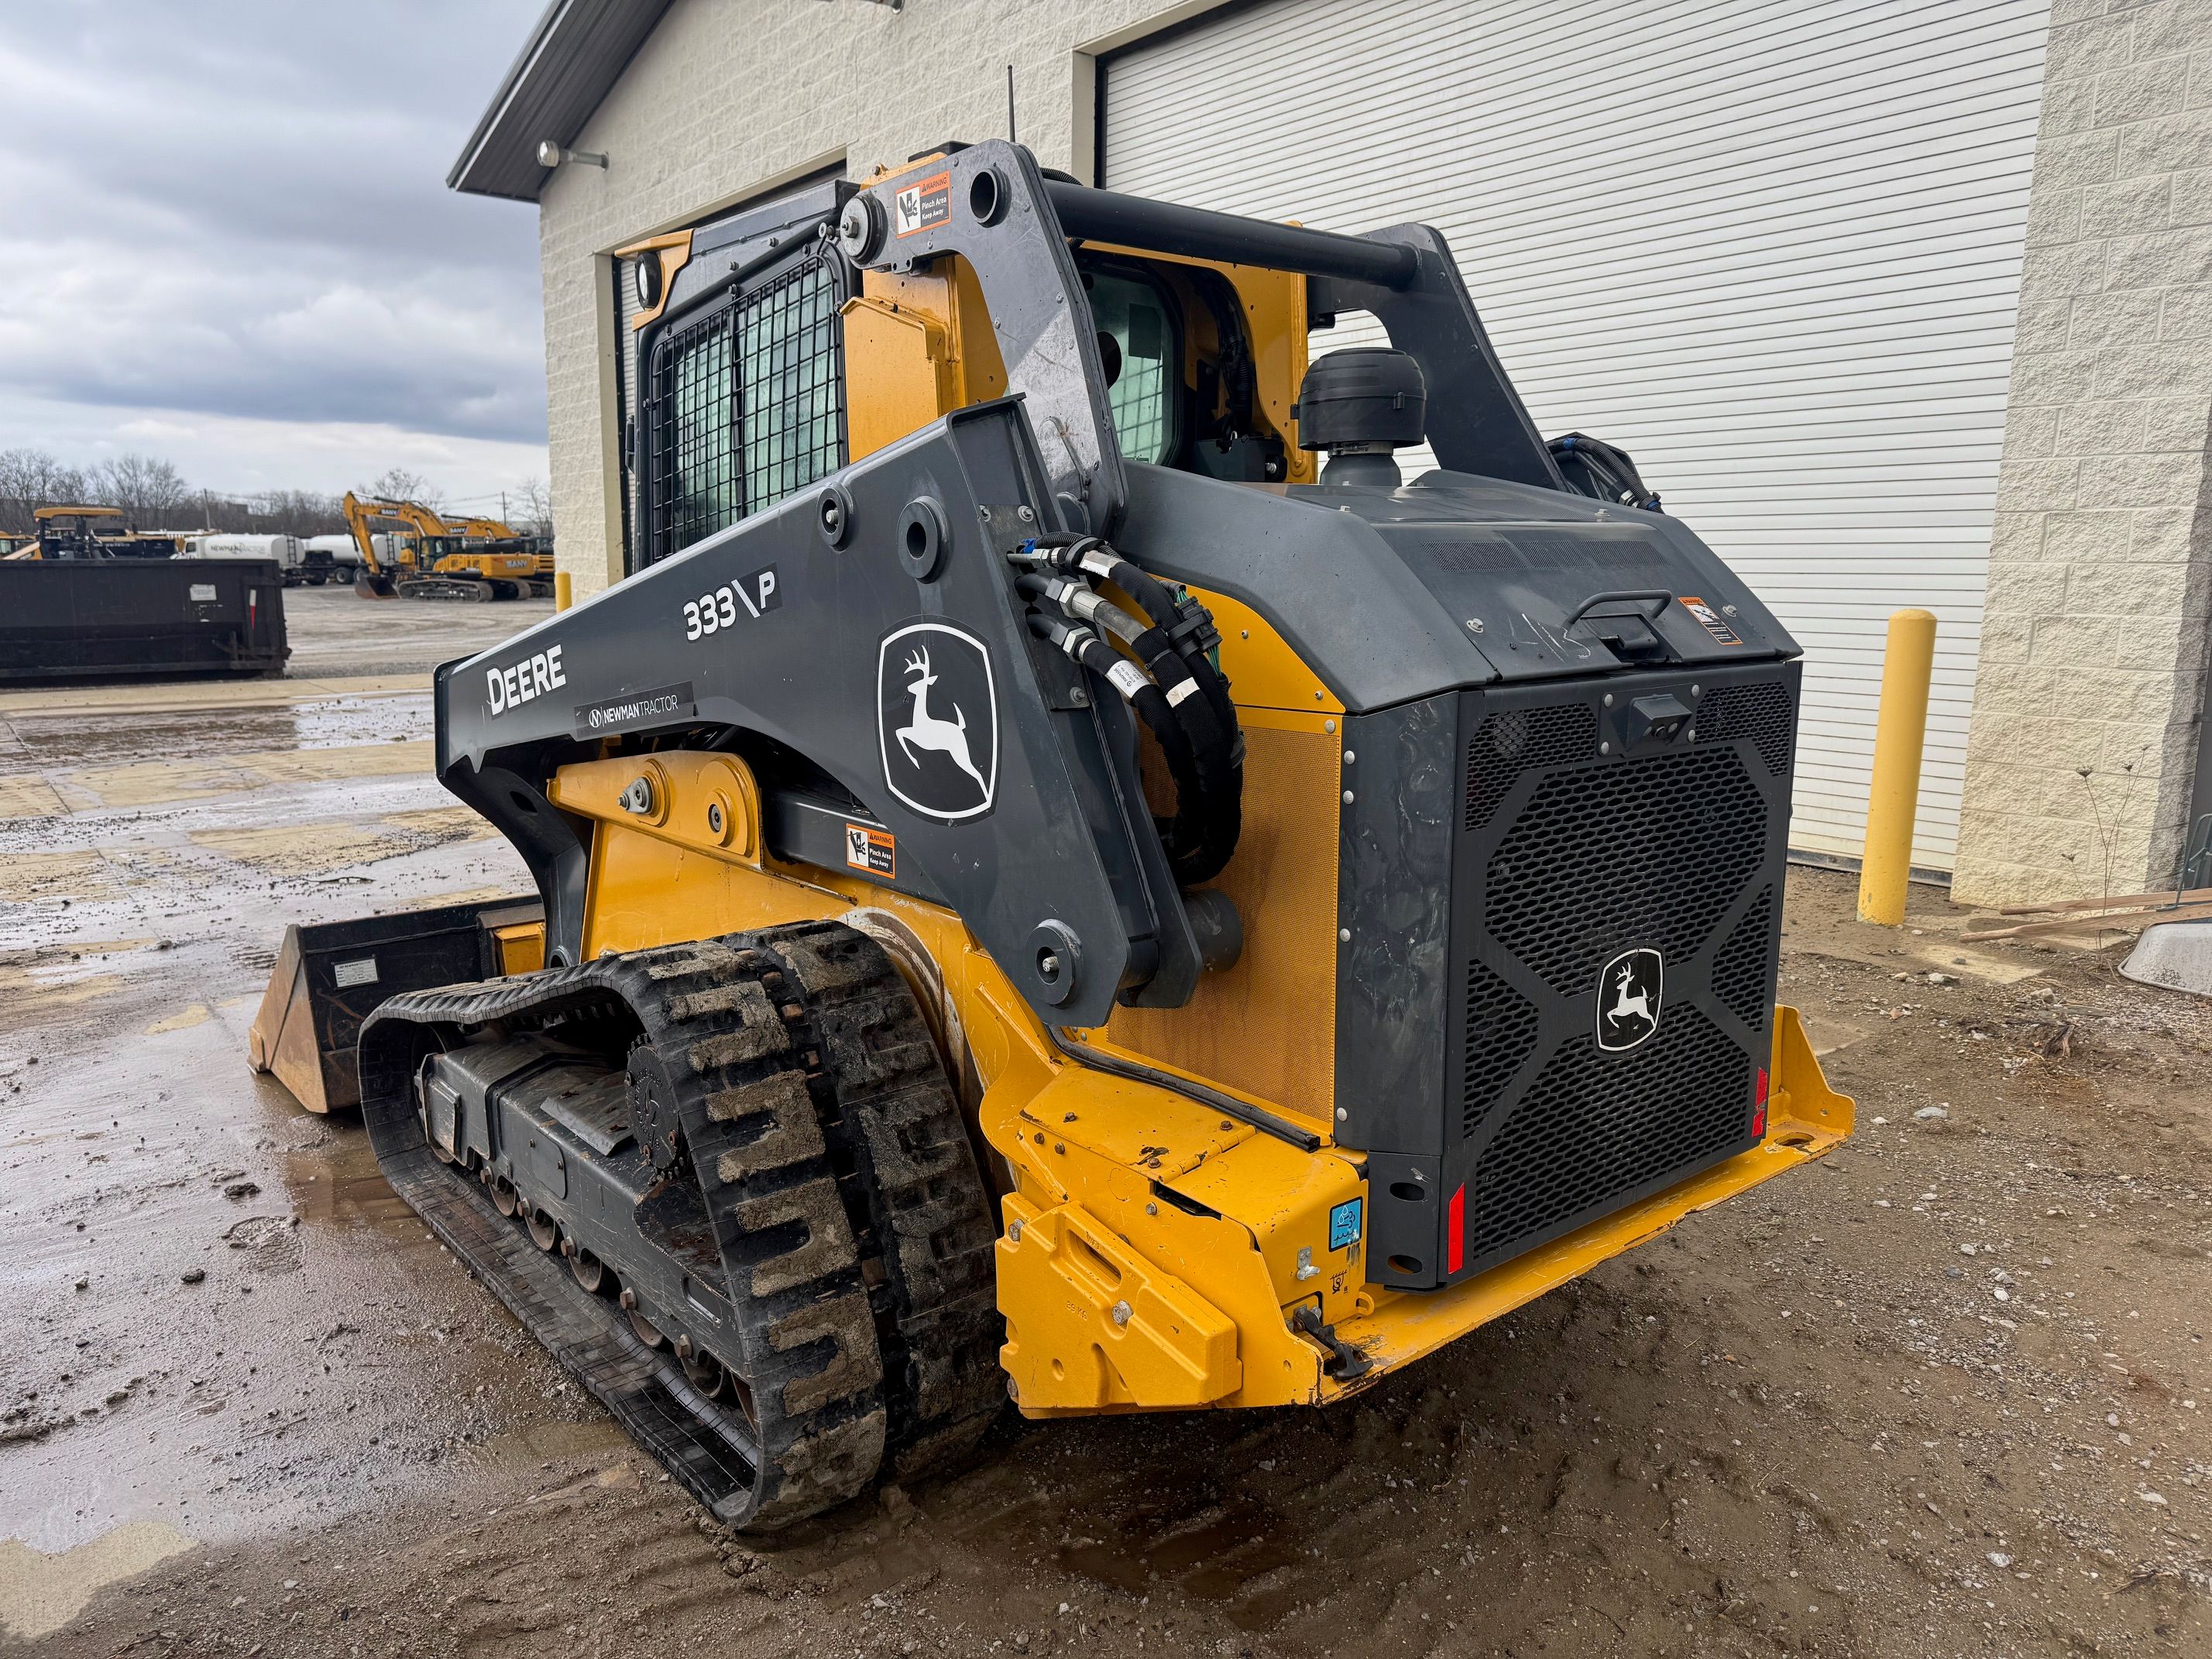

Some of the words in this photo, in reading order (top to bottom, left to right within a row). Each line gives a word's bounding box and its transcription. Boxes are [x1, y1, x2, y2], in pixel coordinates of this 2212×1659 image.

[926, 177, 947, 191] WARNING
[922, 200, 935, 210] Pinch
[936, 197, 946, 206] Area
[922, 212, 933, 221] Keep
[933, 208, 944, 218] Away
[486, 644, 566, 716] DEERE
[873, 835, 891, 845] WARNING
[869, 848, 881, 857] Pinch
[870, 857, 878, 866] Keep
[879, 860, 888, 869] Away
